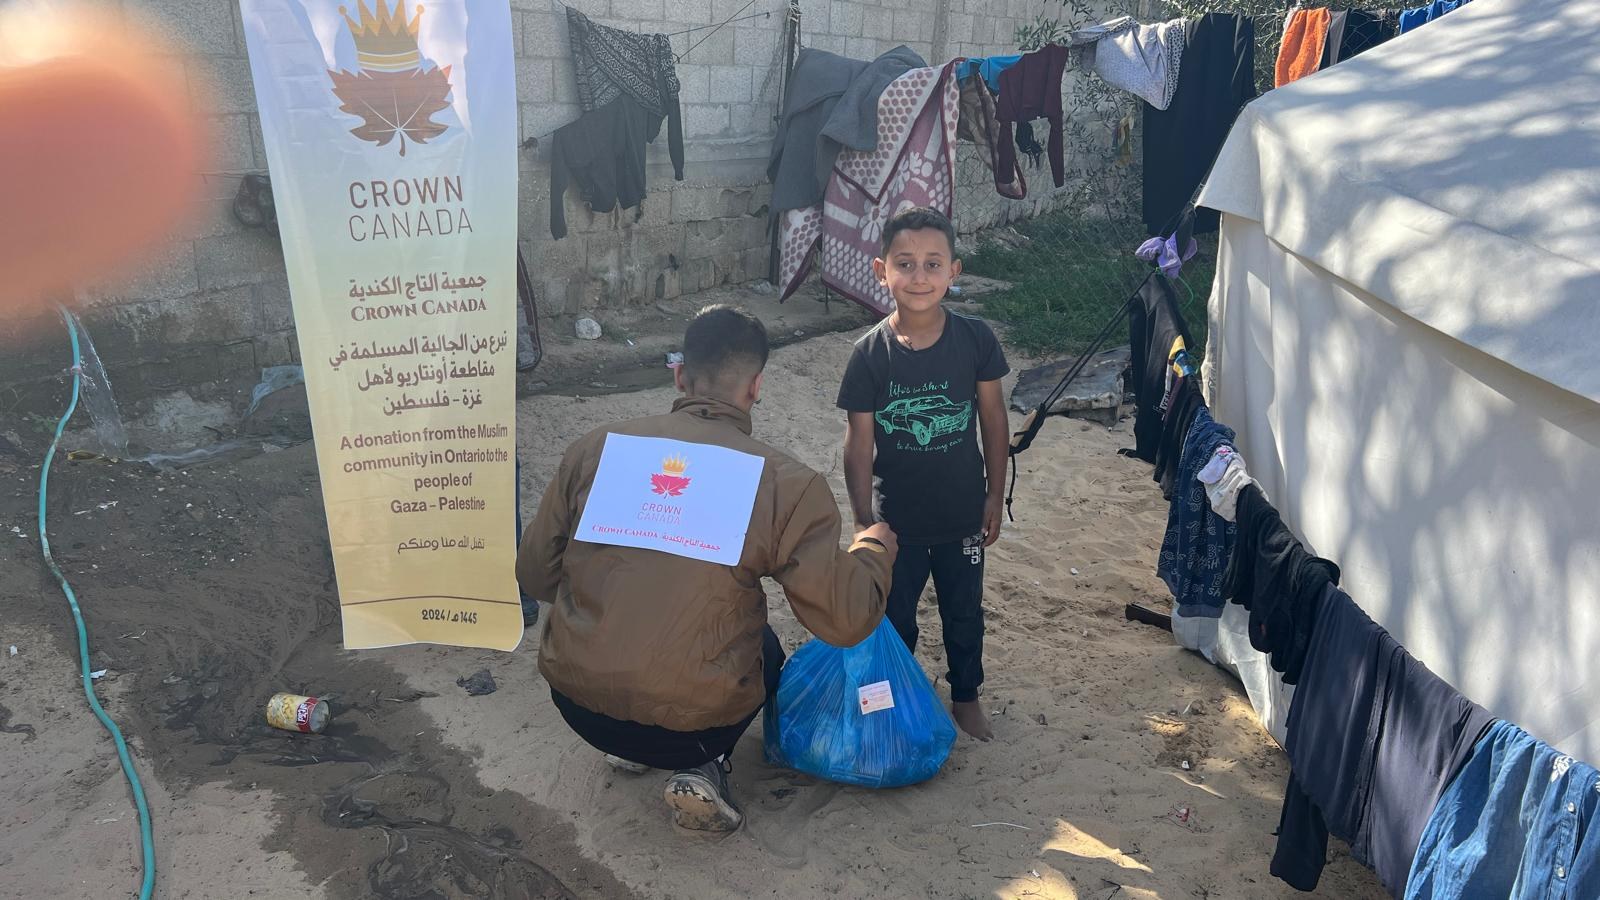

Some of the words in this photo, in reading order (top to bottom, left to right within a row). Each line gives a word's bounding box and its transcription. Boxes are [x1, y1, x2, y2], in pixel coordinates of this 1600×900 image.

[349, 175, 463, 209] CROWN
[349, 208, 473, 241] CANADA
[349, 274, 402, 302] الكندية
[405, 271, 439, 300] التاج
[441, 271, 487, 294] جمعية
[351, 303, 417, 322] CROWN
[421, 297, 488, 315] CANADA
[350, 336, 419, 361] المسلمة
[421, 332, 468, 356] الجالية
[470, 334, 487, 354] من
[329, 344, 348, 371] في
[449, 359, 495, 379] مقاطعة
[358, 362, 394, 392] لأهل
[397, 355, 447, 388] أونتاريو
[383, 389, 450, 416] فلسطين
[462, 388, 483, 409] غزة
[340, 435, 352, 450] A
[354, 429, 421, 448] donation
[423, 427, 456, 441] from
[457, 424, 476, 439] the
[477, 423, 508, 439] Muslim
[343, 451, 428, 473] community
[430, 450, 443, 464] in
[444, 447, 485, 463] Ontario
[486, 448, 494, 462] to
[495, 448, 508, 462] the
[414, 472, 460, 492] people
[461, 472, 472, 487] of
[391, 499, 427, 514] Gaza
[438, 496, 485, 511] Palestine
[641, 502, 681, 515] CROWN
[637, 511, 680, 525] CANADA
[397, 537, 439, 555] ومنكم
[441, 536, 456, 548] منا
[421, 608, 445, 621] 2024
